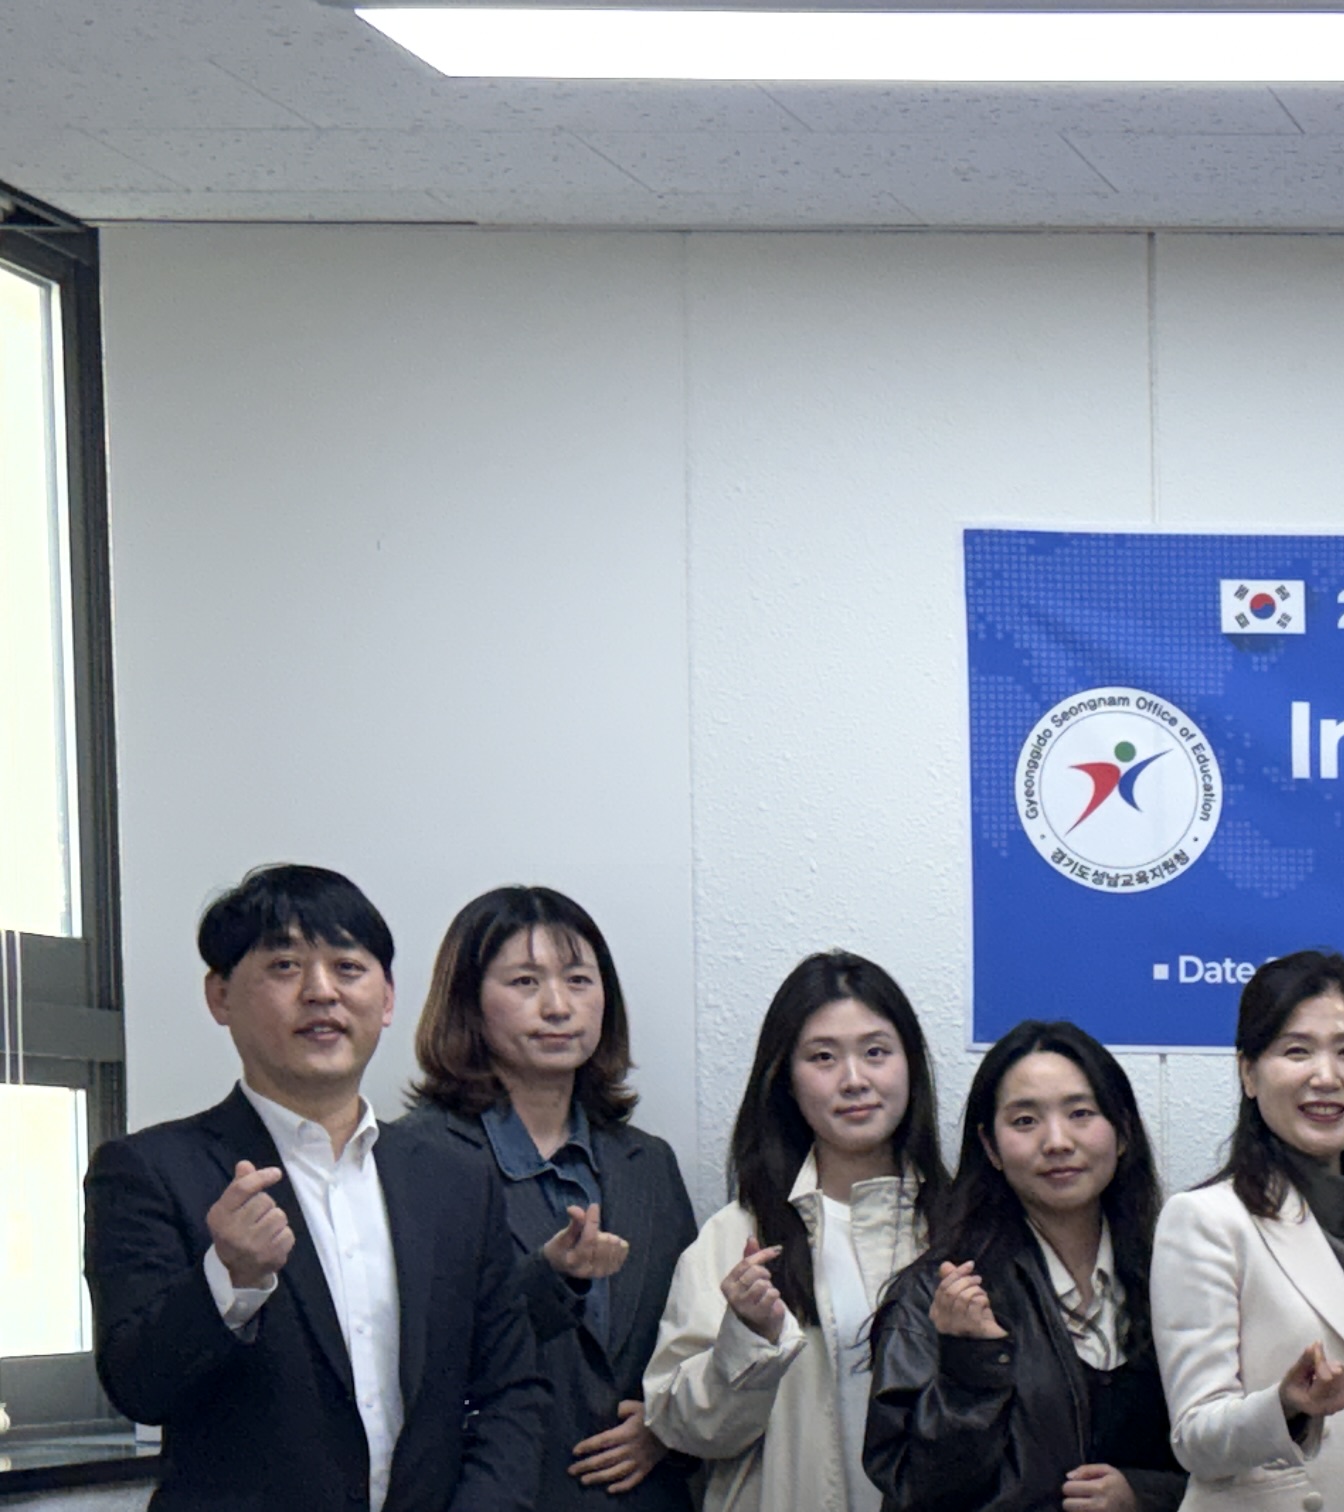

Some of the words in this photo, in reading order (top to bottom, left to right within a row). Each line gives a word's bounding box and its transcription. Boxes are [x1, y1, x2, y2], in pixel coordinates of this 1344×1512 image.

[1024, 728, 1053, 820] Gyeonggido
[1051, 696, 1130, 727] Seongnam
[1135, 697, 1178, 726] Office
[1179, 727, 1196, 742] of
[1191, 743, 1216, 822] Education
[1178, 955, 1256, 984] Date
